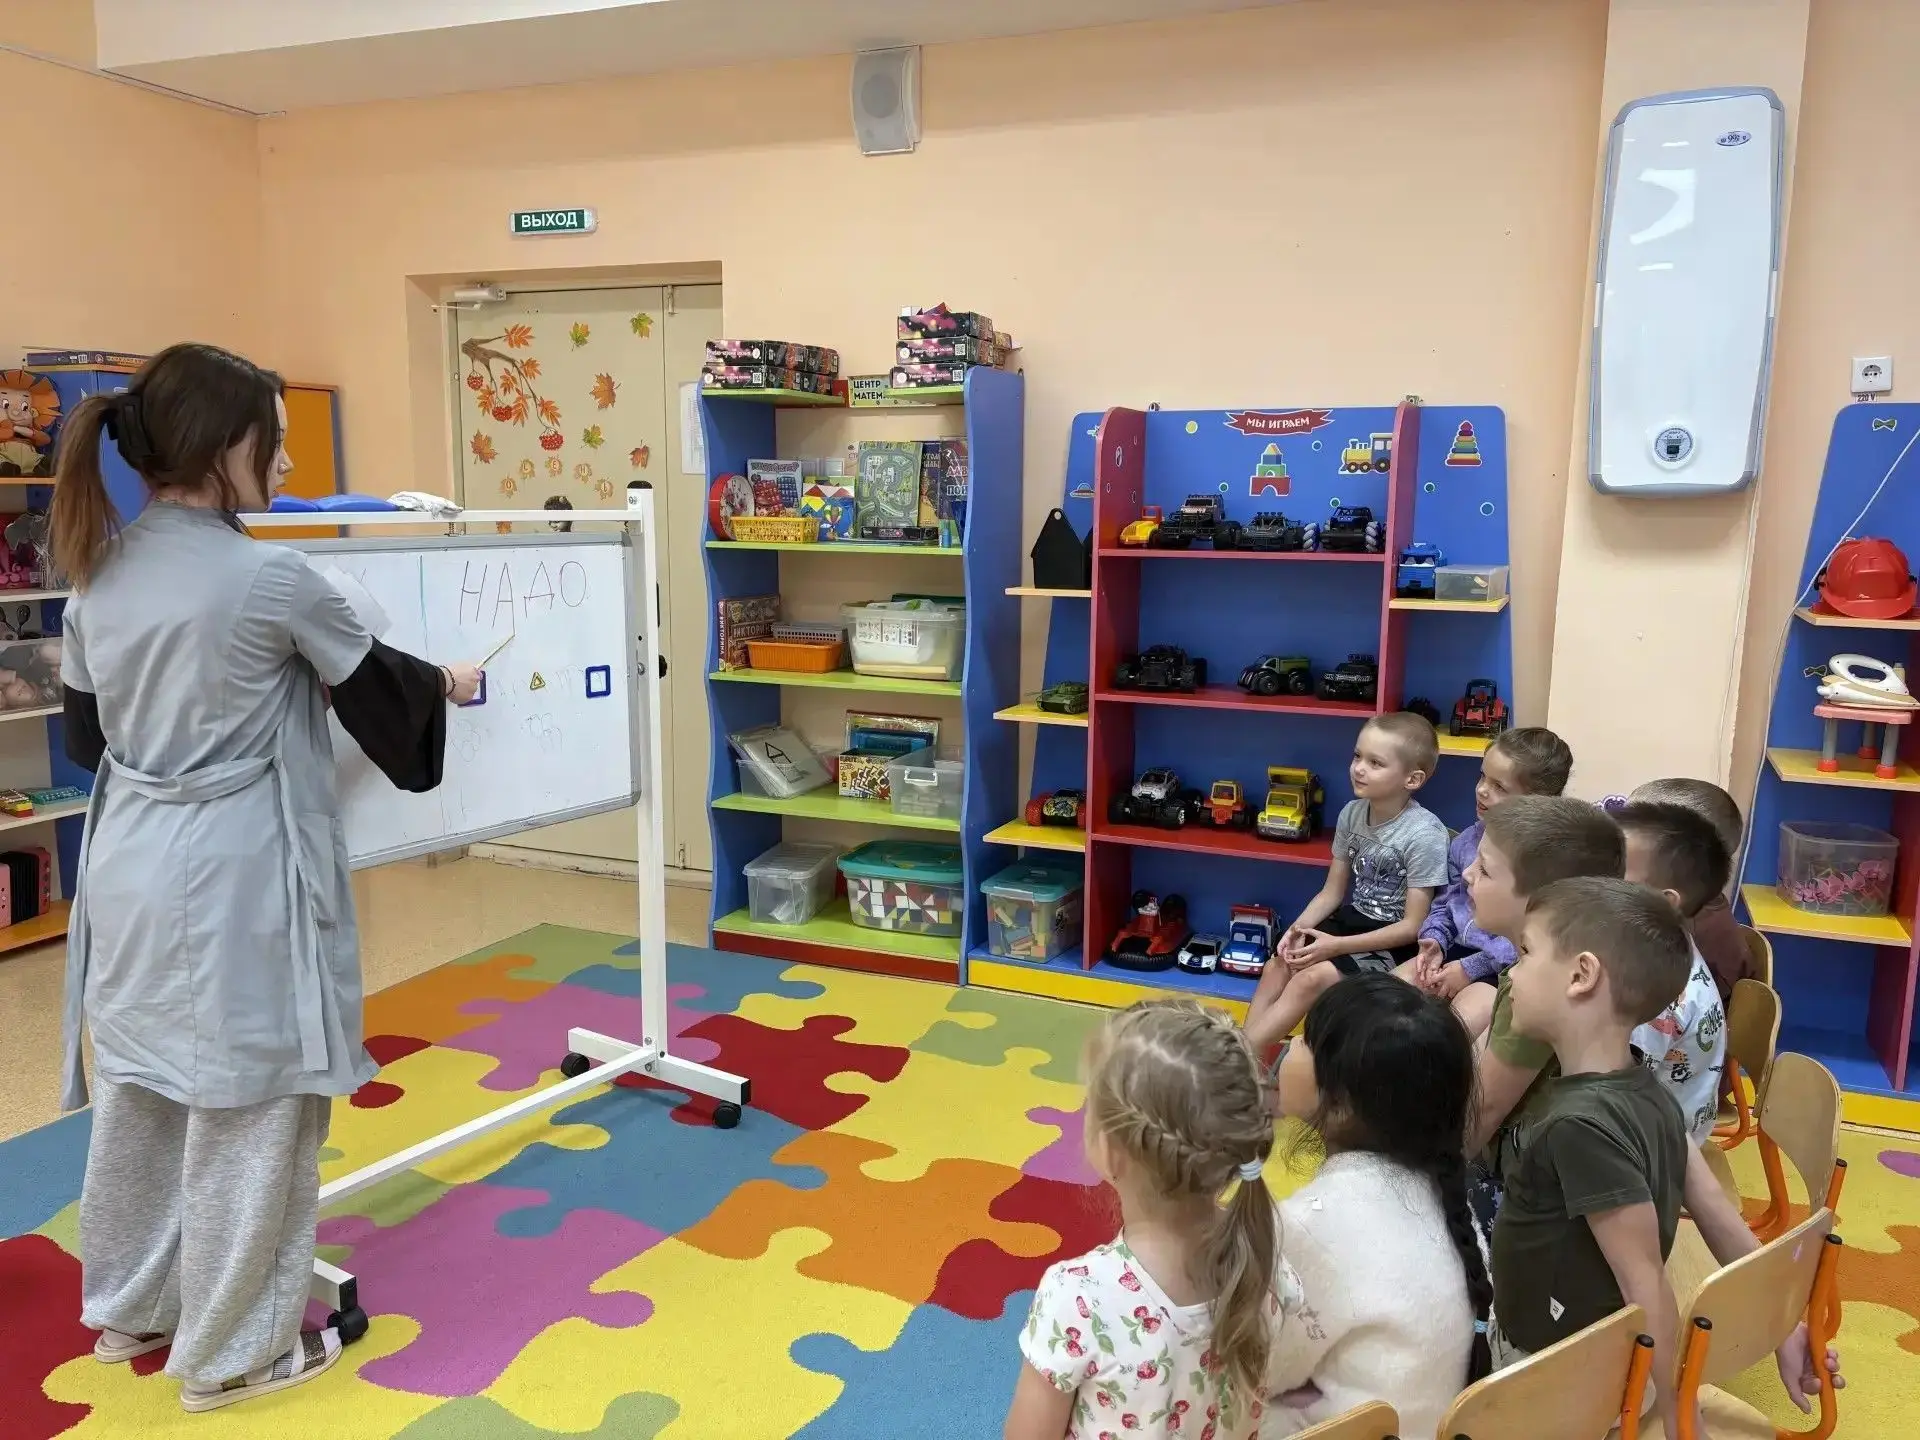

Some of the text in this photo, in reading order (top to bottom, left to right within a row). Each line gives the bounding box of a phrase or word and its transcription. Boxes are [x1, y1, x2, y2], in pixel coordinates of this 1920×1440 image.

[521, 211, 578, 229] ВЫХОД
[853, 380, 881, 389] ЦЕНТР
[854, 391, 885, 400] МАТЕМ
[1857, 392, 1876, 402] 220 V
[1246, 416, 1310, 429] МЫ ИГРАЕМ
[458, 560, 588, 636] НАДО
[733, 624, 771, 638] ВИКТОРИН
